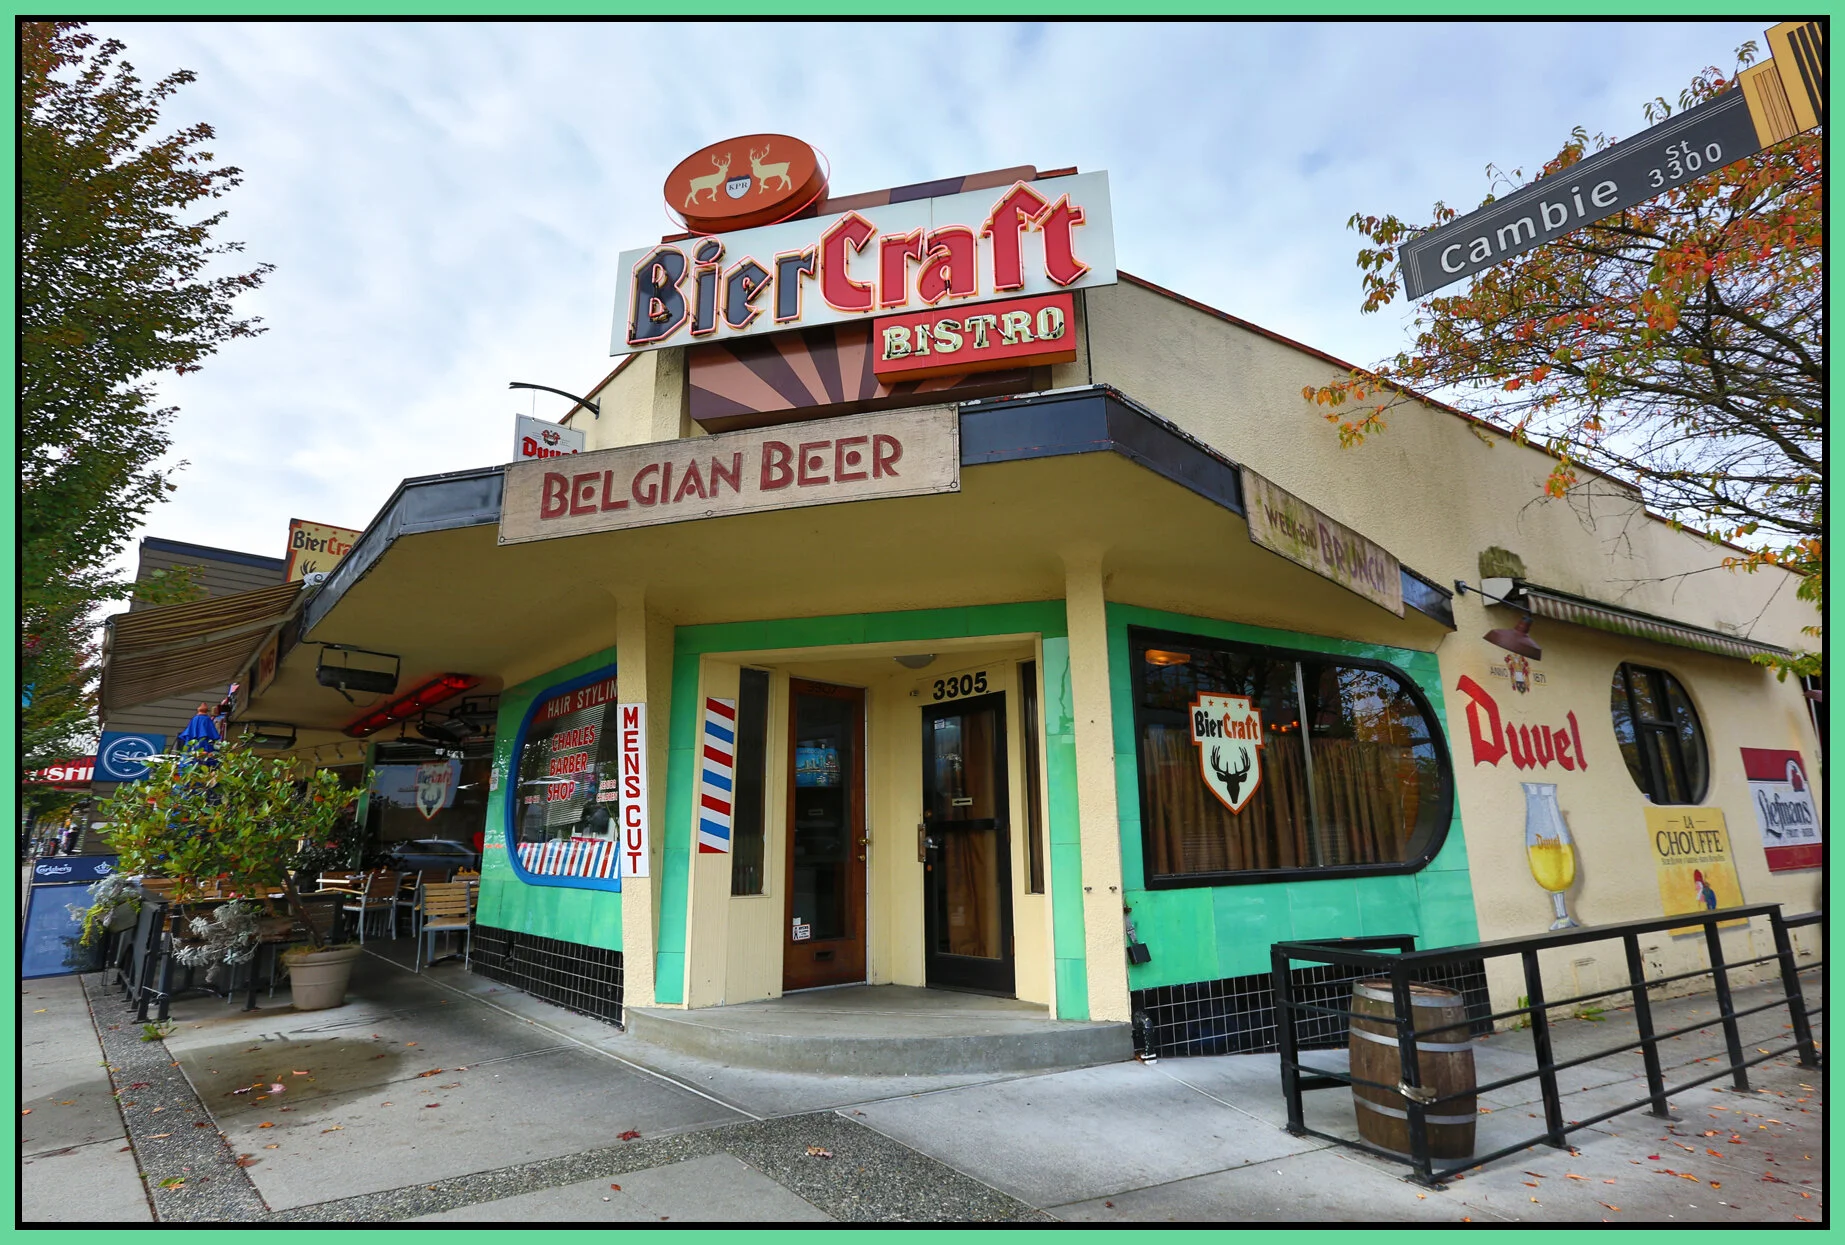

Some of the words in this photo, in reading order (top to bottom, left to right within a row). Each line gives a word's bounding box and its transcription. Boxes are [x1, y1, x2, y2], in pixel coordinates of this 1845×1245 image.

[1665, 140, 1689, 160] St
[728, 182, 748, 190] KPR
[1440, 179, 1619, 274] Cambie
[1648, 142, 1722, 188] 3300
[627, 180, 1092, 346] BierCraft
[881, 306, 1065, 361] BISTRO
[539, 450, 742, 521] BELGIAN
[759, 433, 903, 491] BEER
[1318, 521, 1386, 595] BRUNCH
[932, 671, 988, 701] 3305
[548, 695, 571, 719] HAIR
[1194, 710, 1259, 740] BierCraft
[1456, 674, 1588, 772] Duvel
[551, 725, 595, 752] CHARLES
[623, 706, 641, 799] MENS
[549, 752, 589, 776] BARBER
[546, 781, 575, 802] SHOP
[1682, 815, 1695, 830] LA
[1758, 789, 1813, 839] Liefmans
[625, 804, 642, 874] CUT
[1656, 830, 1724, 857] CHOUFFE
[36, 863, 73, 876] Carlsberg
